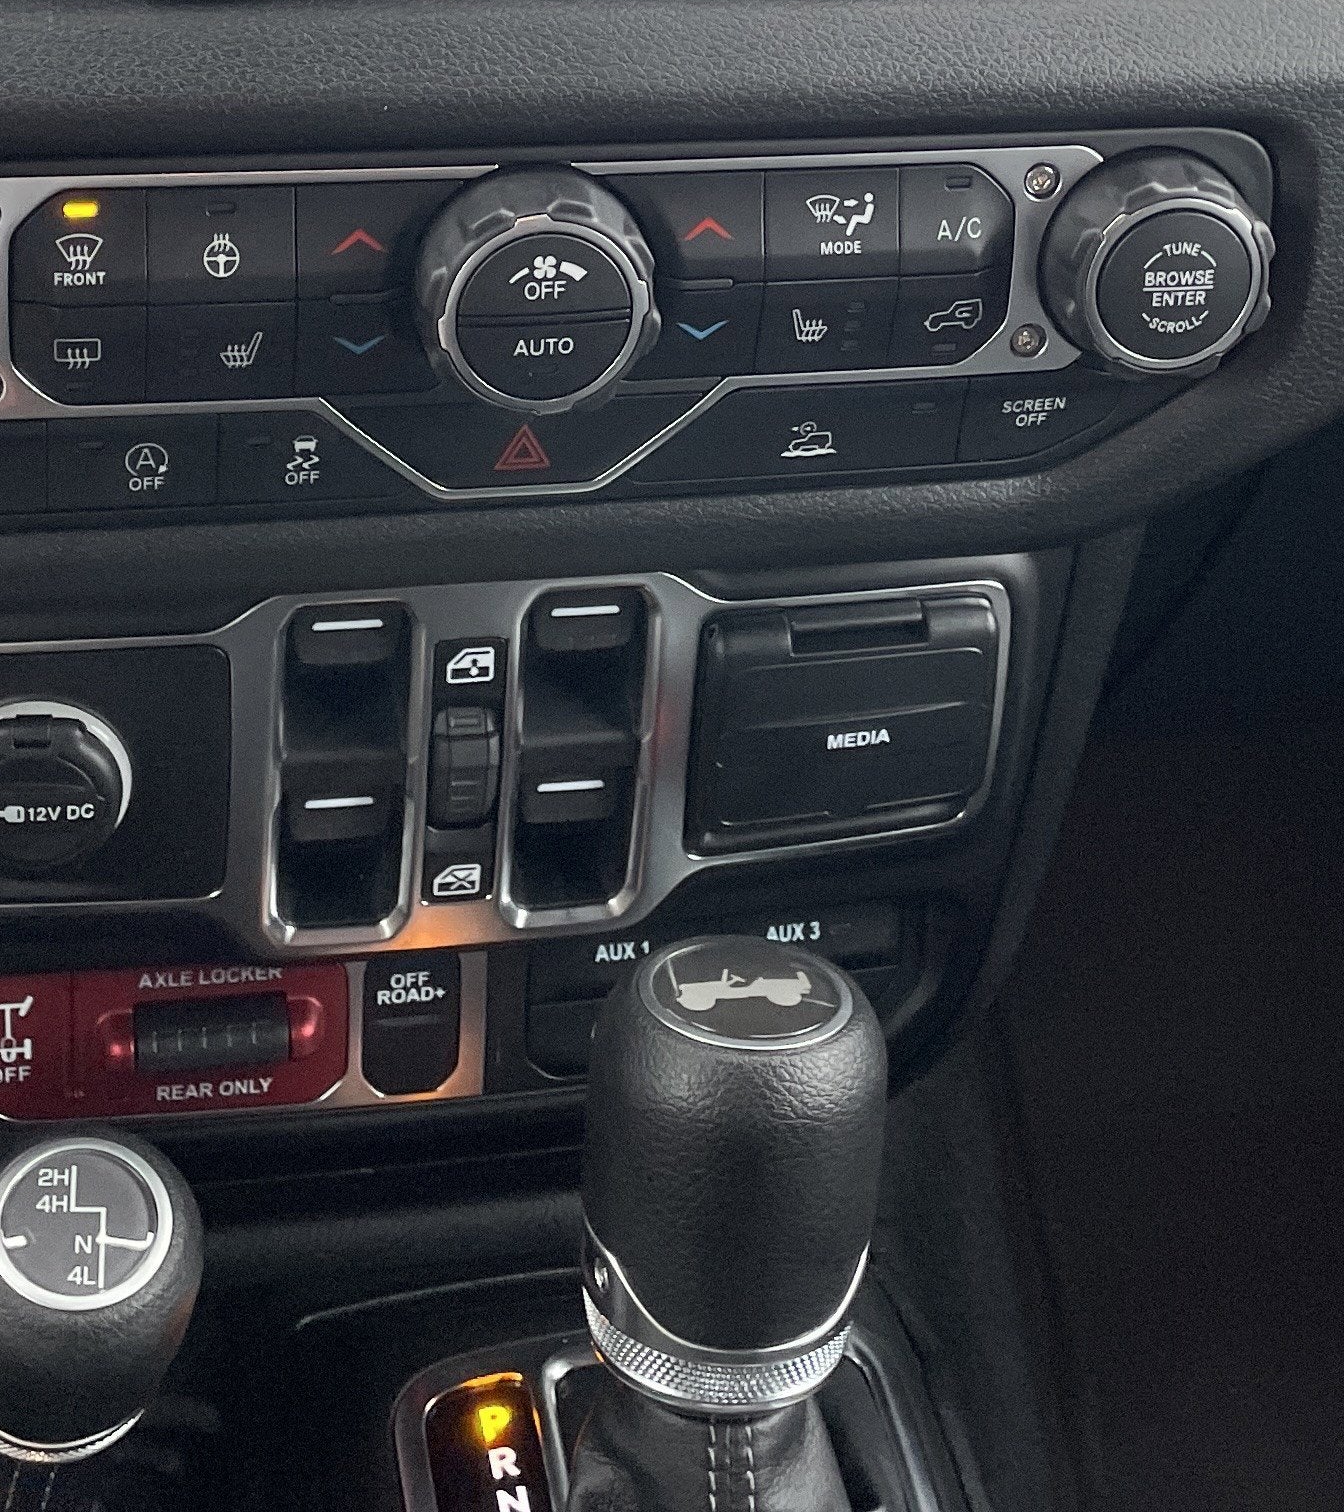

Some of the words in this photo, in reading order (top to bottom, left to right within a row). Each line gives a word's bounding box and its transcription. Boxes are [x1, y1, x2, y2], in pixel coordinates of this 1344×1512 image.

[936, 215, 983, 242] A/C
[819, 240, 862, 256] MODE
[1162, 241, 1202, 257] TUNE
[53, 271, 106, 287] FRONT
[1144, 269, 1215, 286] BROWSE
[524, 281, 567, 301] OFF
[1152, 291, 1207, 307] ENTER
[1148, 316, 1203, 334] SCROLL
[513, 336, 574, 358] AUTO
[1002, 397, 1066, 415] SCREEN
[1015, 412, 1048, 428] OFF
[128, 476, 166, 492] OFF
[284, 470, 320, 486] OFF
[826, 728, 891, 750] MEDIA
[26, 805, 61, 822] 12V
[66, 802, 96, 821] DC
[766, 923, 805, 944] AUX
[809, 920, 821, 940] 3
[594, 942, 637, 963] AUX
[640, 939, 650, 957] 1
[139, 970, 194, 989] AXLE
[199, 967, 283, 985] LOCKER
[389, 972, 431, 990] OFF
[156, 1082, 213, 1102] REAR
[219, 1077, 274, 1097] ONLY
[37, 1168, 69, 1186] 2H
[36, 1194, 68, 1213] 4H
[74, 1234, 92, 1254] N
[67, 1265, 96, 1285] 4L
[478, 1405, 512, 1444] P
[488, 1446, 521, 1480] R
